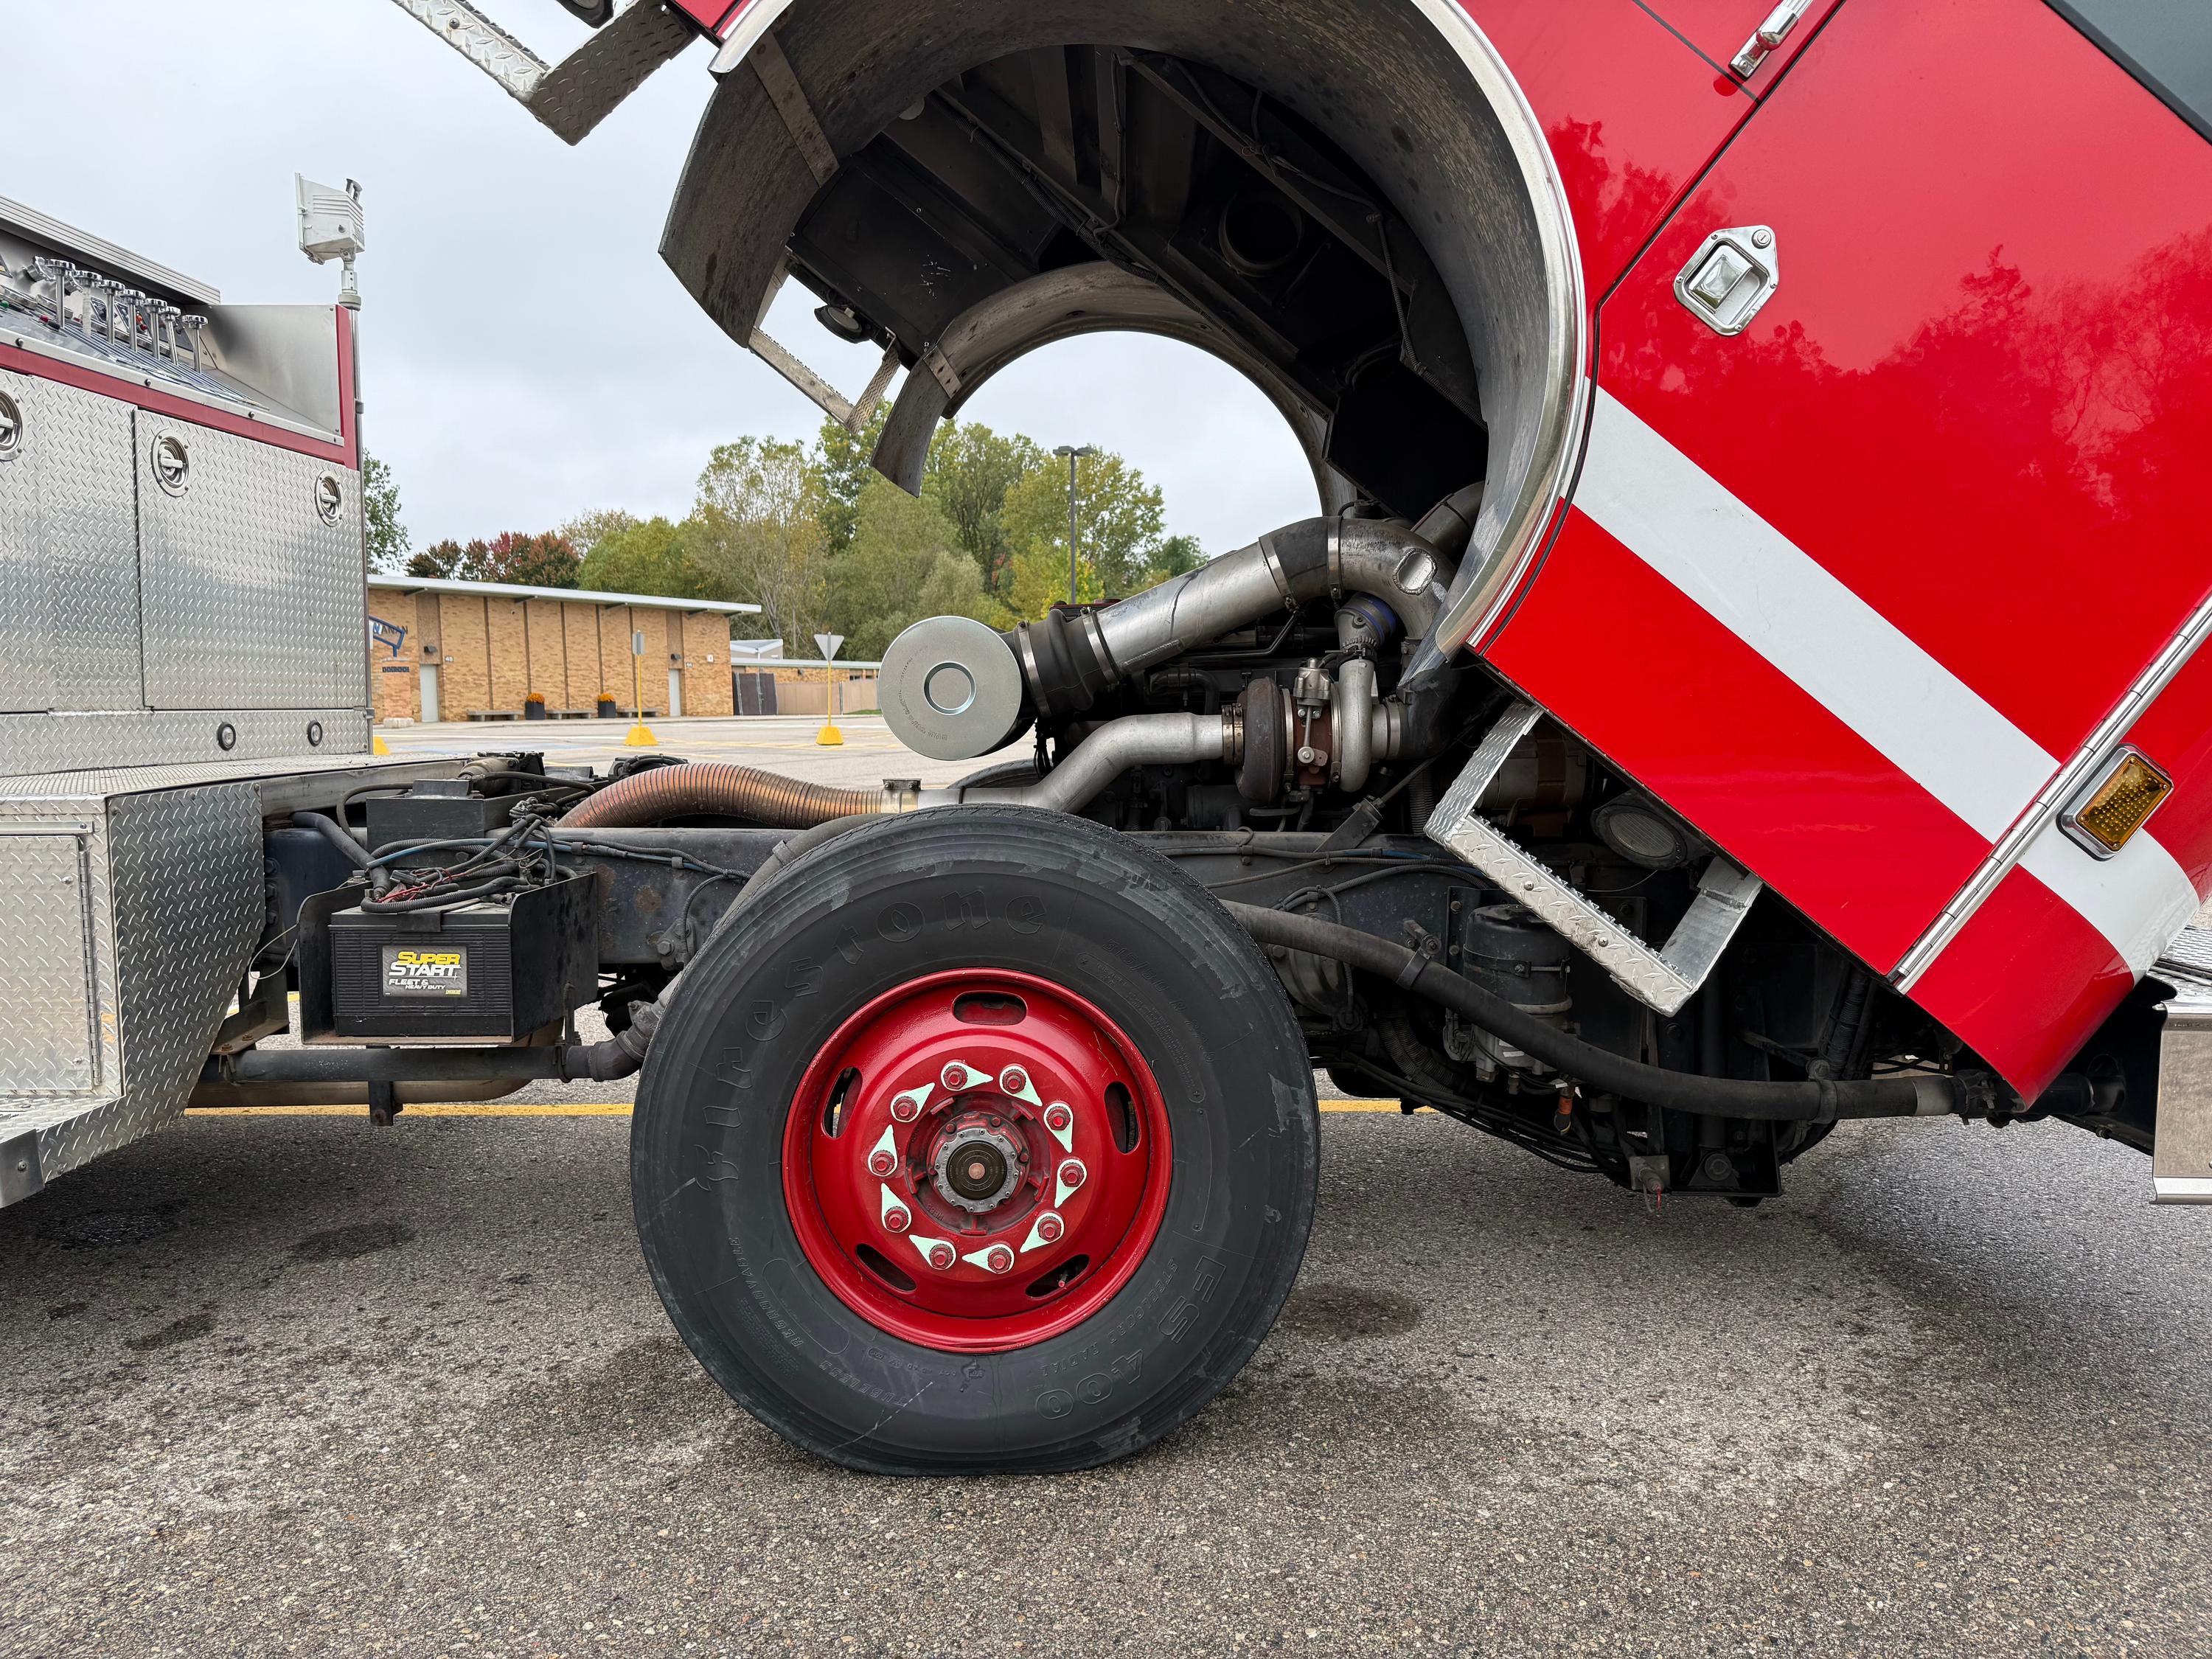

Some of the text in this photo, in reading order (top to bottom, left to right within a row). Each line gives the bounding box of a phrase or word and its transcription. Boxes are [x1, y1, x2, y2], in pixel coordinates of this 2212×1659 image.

[389, 961, 462, 976] START
[397, 951, 461, 965] SUPER
[695, 889, 1048, 1192] Firestone
[728, 1237, 804, 1349] REGROOVABLE
[1034, 1255, 1227, 1420] FS 400
[1040, 1341, 1102, 1377] RADIAL
[819, 1360, 910, 1408] TUBELESS
